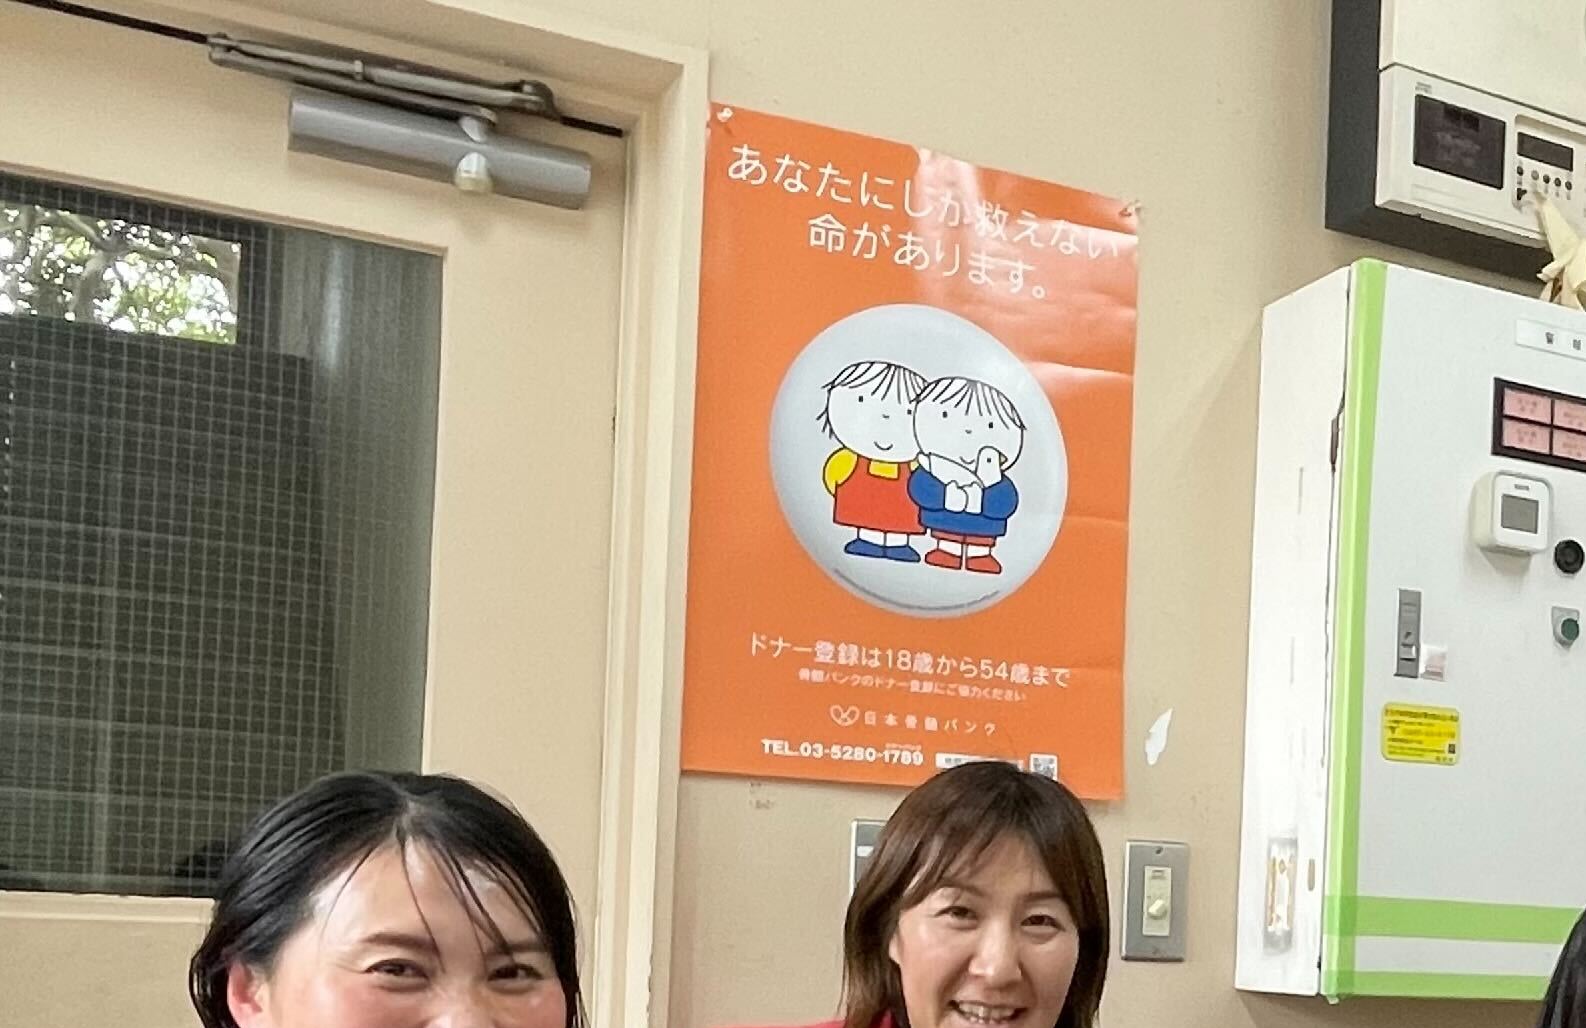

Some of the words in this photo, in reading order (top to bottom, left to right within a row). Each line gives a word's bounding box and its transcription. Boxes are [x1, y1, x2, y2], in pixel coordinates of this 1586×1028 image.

[727, 143, 1119, 260] あなたにしか救えない
[808, 213, 1046, 300] 命があります。
[751, 632, 1071, 688] ドナー登録は18歳から54歳まで
